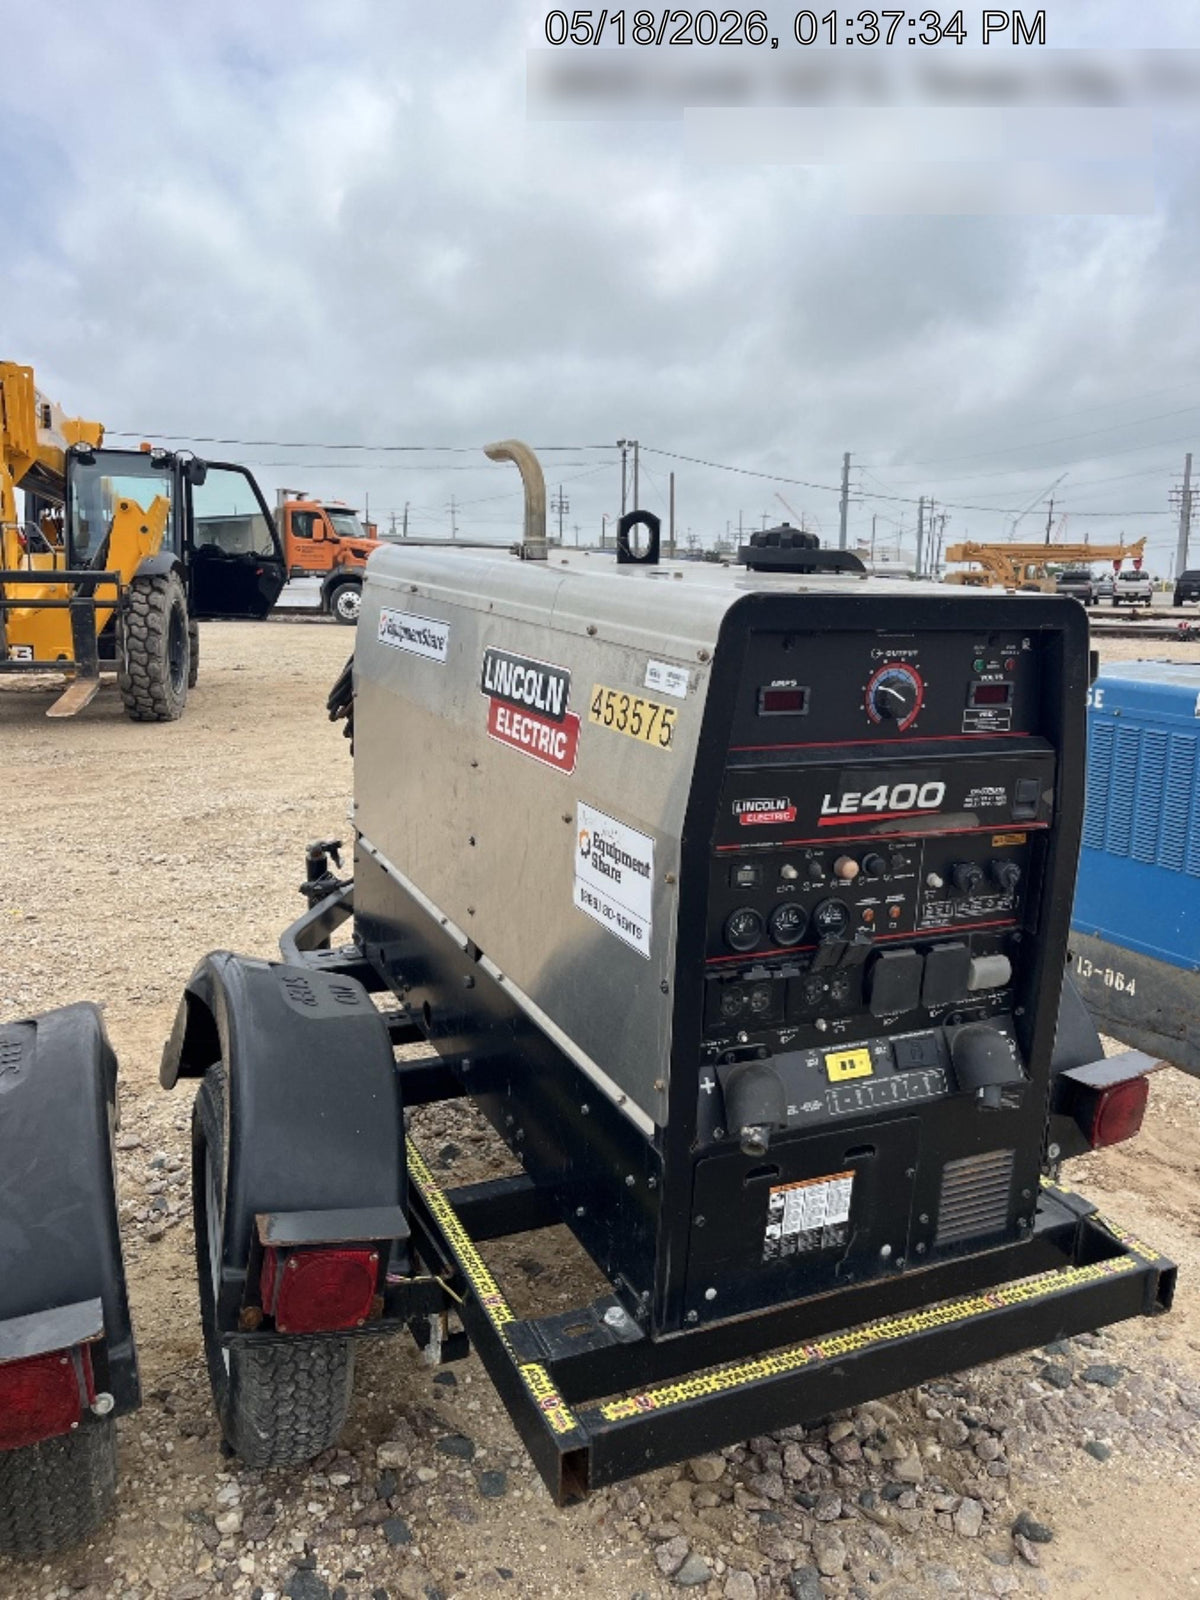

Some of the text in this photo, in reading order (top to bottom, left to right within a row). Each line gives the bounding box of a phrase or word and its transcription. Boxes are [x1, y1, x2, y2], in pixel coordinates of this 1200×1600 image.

[484, 655, 565, 716] LINCOLN
[495, 706, 568, 761] ELECTRIC
[591, 688, 675, 747] 453575
[735, 800, 786, 813] LINCOLN
[821, 782, 946, 815] LE400
[746, 811, 791, 823] ELECTRIC
[591, 851, 622, 884] Share
[593, 831, 651, 879] Equipment
[525, 1368, 548, 1394] AQUI
[655, 1390, 678, 1402] DO
[682, 1379, 713, 1396] NOT
[715, 1366, 765, 1387] STAND
